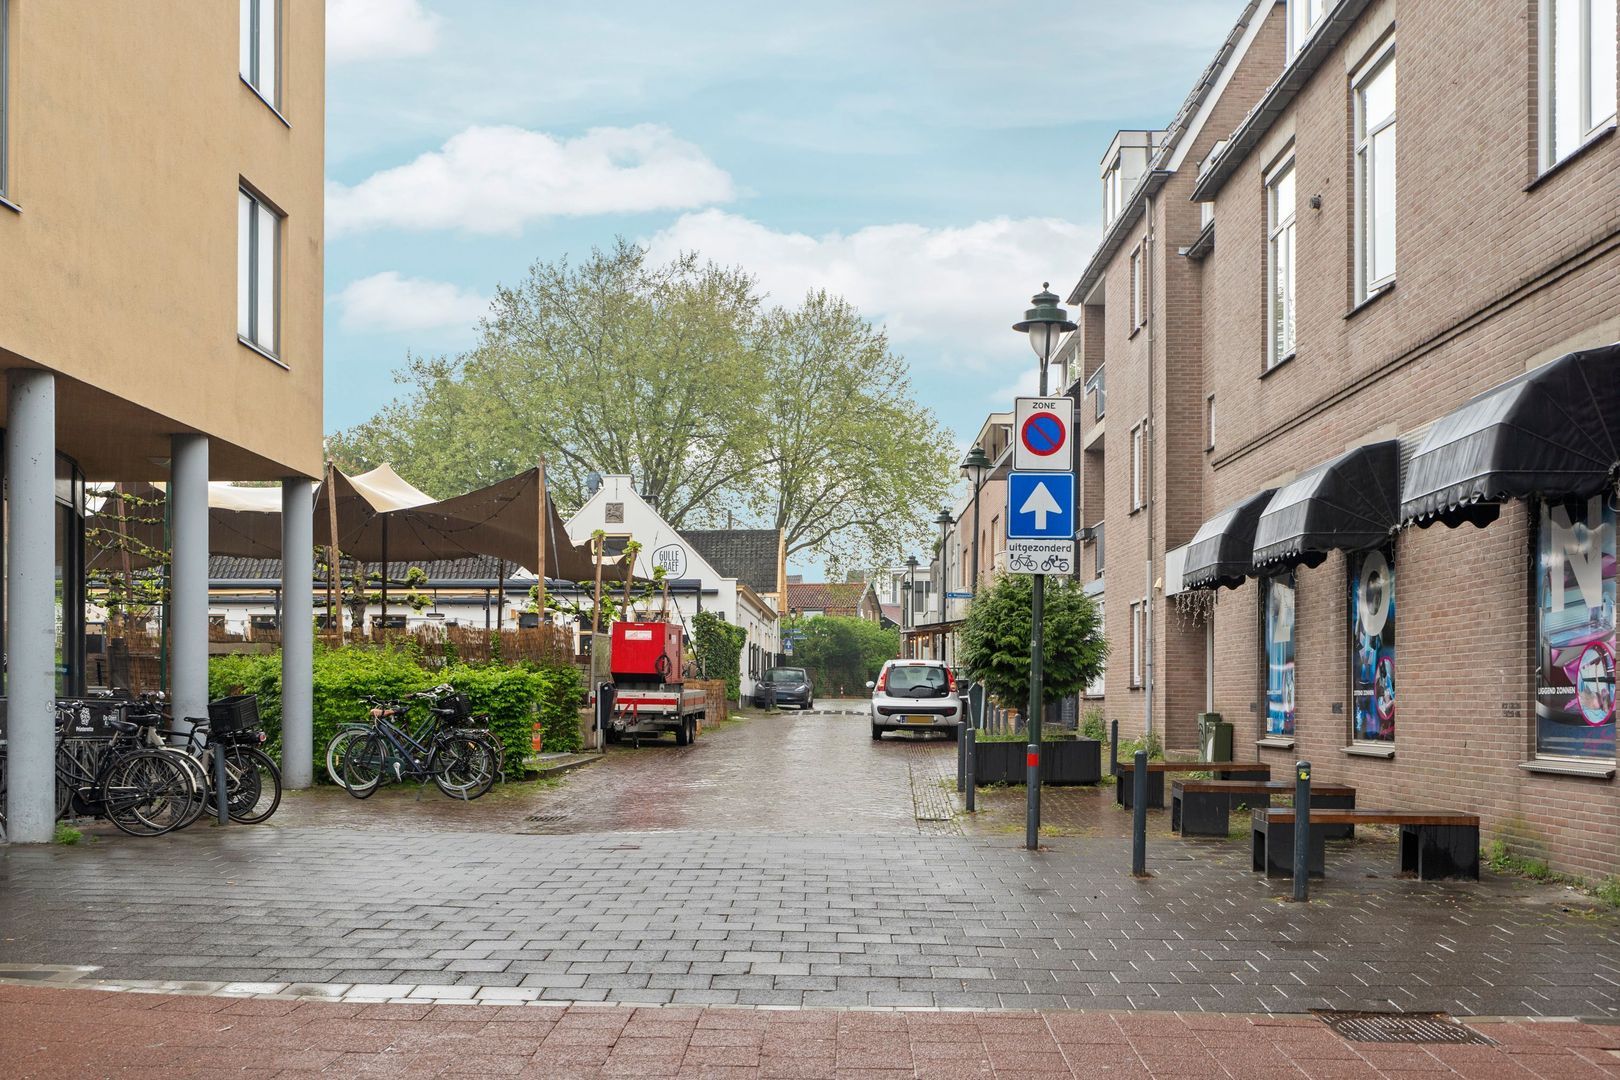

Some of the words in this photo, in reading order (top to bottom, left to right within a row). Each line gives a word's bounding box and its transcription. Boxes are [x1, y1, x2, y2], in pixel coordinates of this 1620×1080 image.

[1009, 543, 1071, 554] uitgezonderd
[659, 550, 679, 561] GULLE
[1359, 550, 1390, 636] O
[1551, 494, 1602, 613] N
